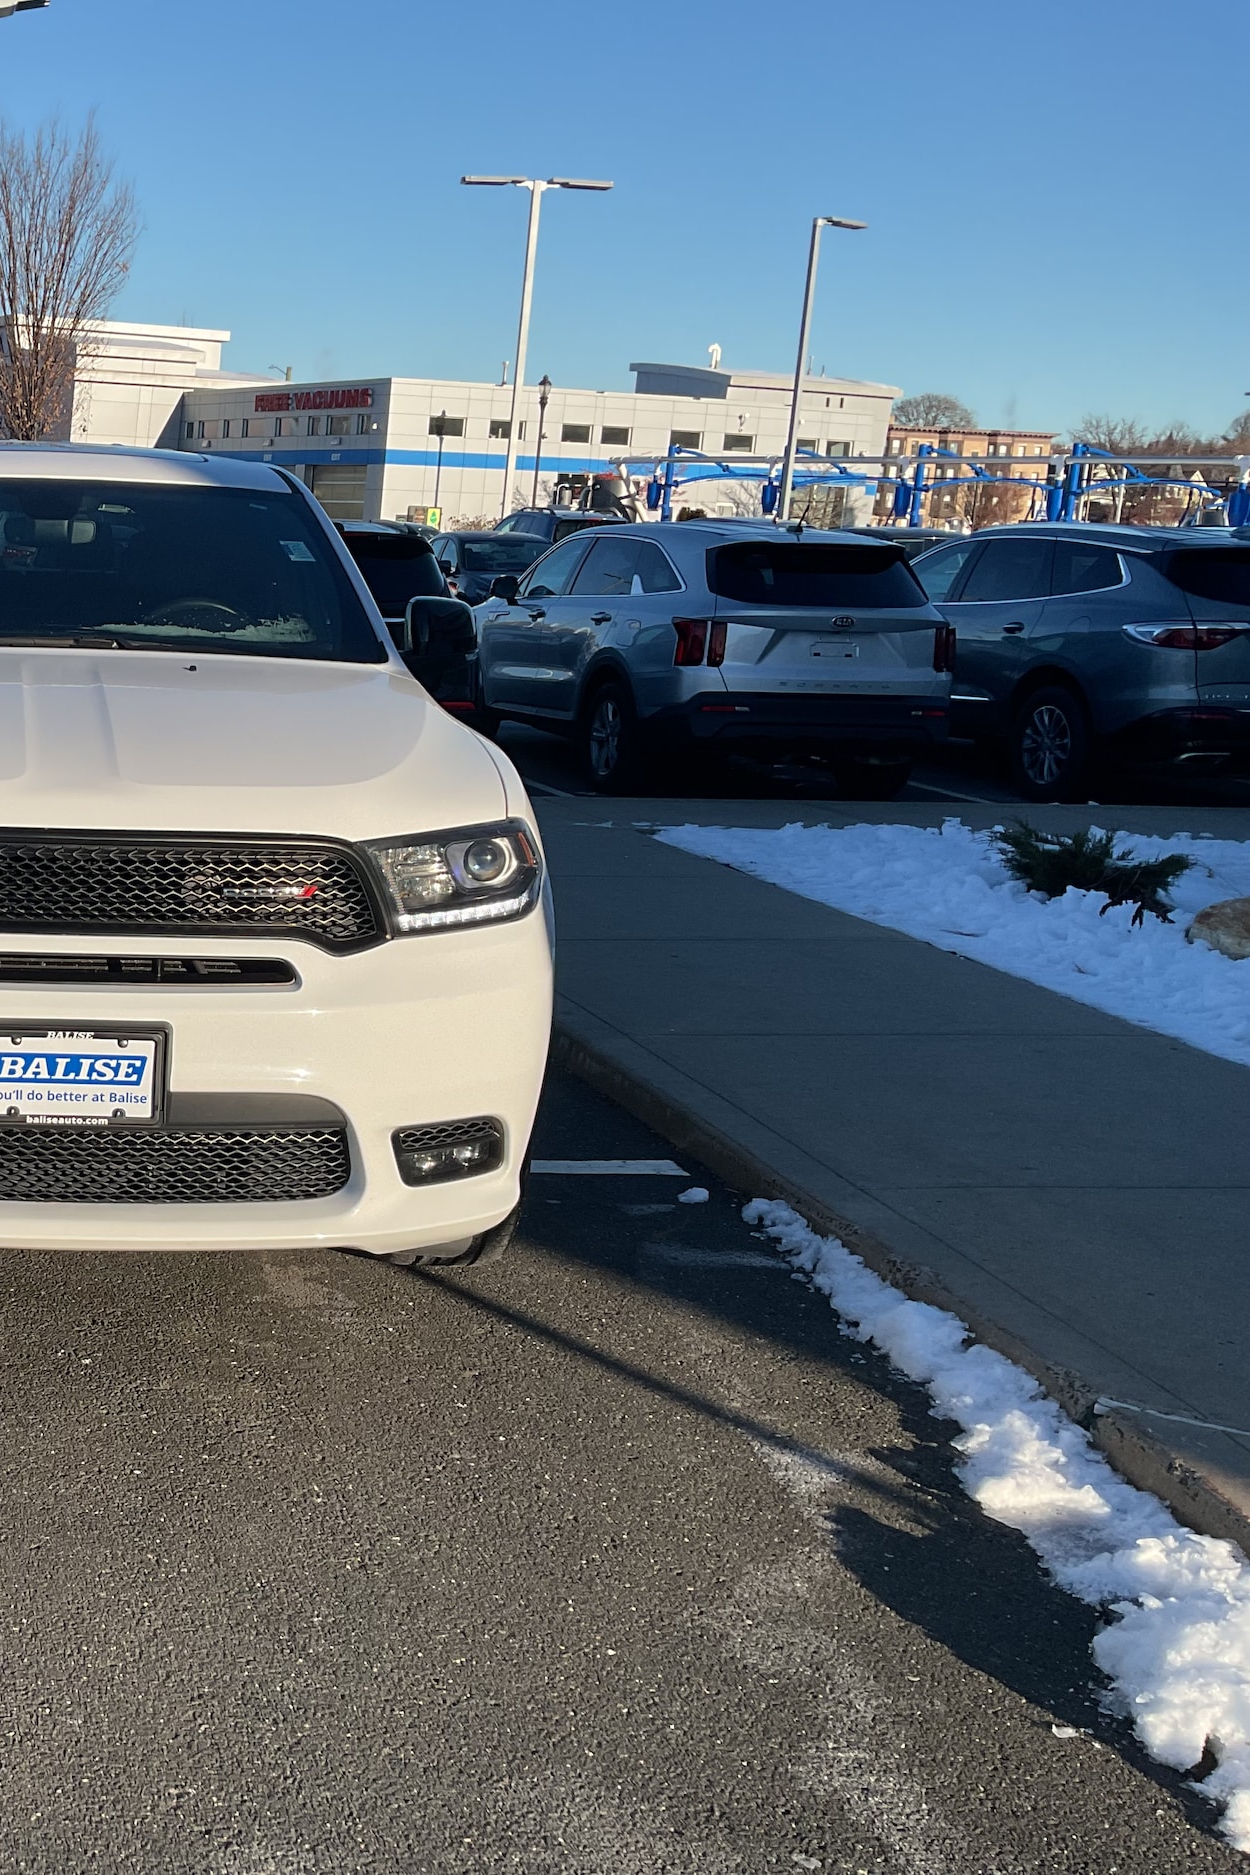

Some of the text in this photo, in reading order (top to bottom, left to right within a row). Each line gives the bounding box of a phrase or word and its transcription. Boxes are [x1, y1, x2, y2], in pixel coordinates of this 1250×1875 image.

[254, 388, 373, 412] FREE VACUUMS
[47, 1031, 95, 1040] BALISE
[27, 1090, 43, 1101] do
[47, 1090, 89, 1102] better
[91, 1092, 106, 1103] at
[109, 1092, 148, 1104] Balise
[26, 1115, 109, 1126] baliseauto.com
